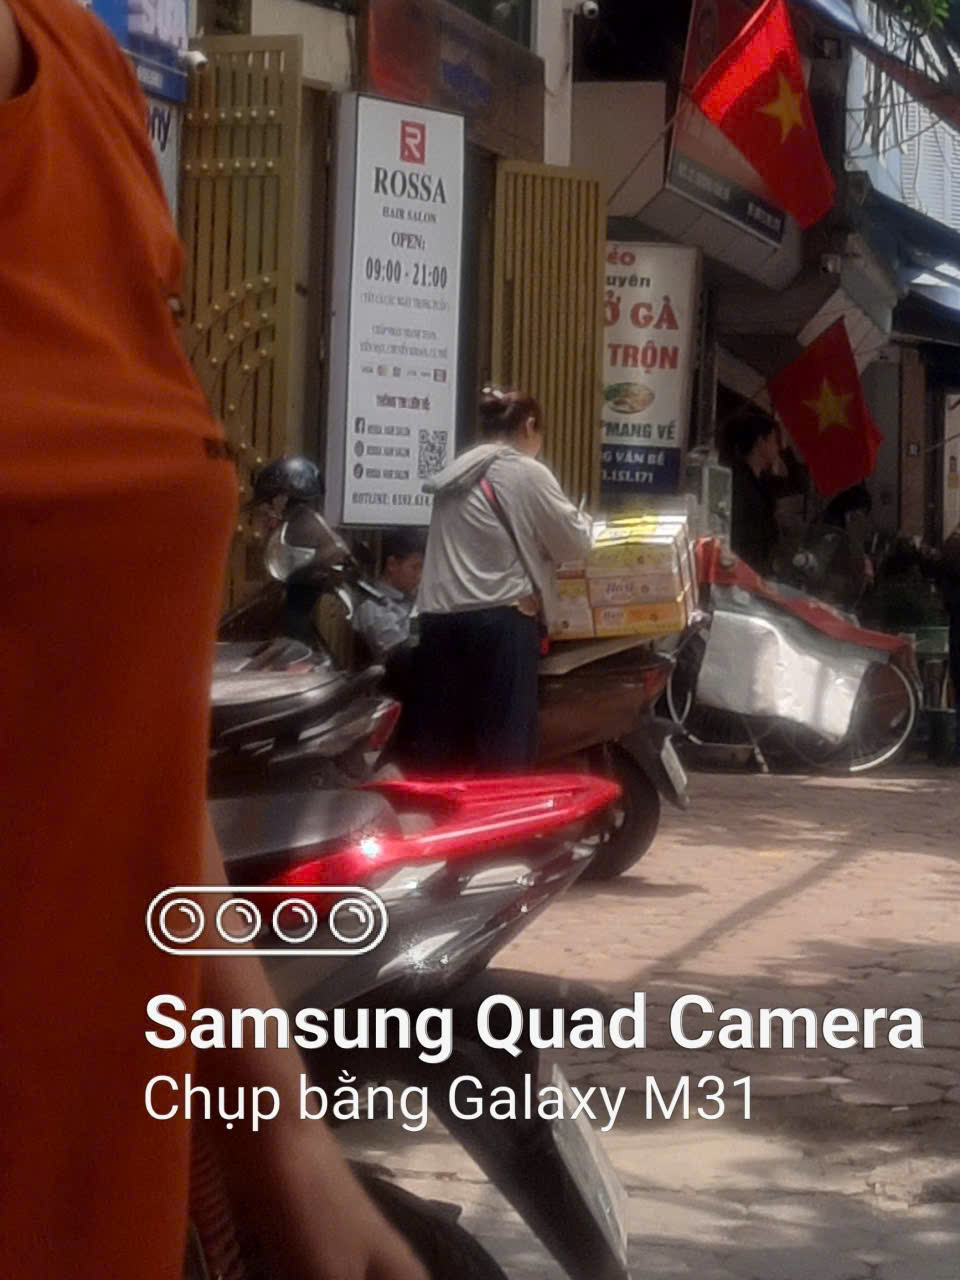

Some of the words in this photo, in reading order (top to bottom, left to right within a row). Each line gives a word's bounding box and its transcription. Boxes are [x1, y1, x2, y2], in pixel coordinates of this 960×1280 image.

[148, 106, 171, 153] ny
[373, 166, 447, 204] ROSSA
[407, 209, 437, 224] SALON
[391, 231, 426, 251] OPEN:
[365, 256, 401, 284] 09:00
[412, 263, 448, 289] 21:00
[605, 274, 652, 289] uyên
[608, 339, 680, 375] TRỘN
